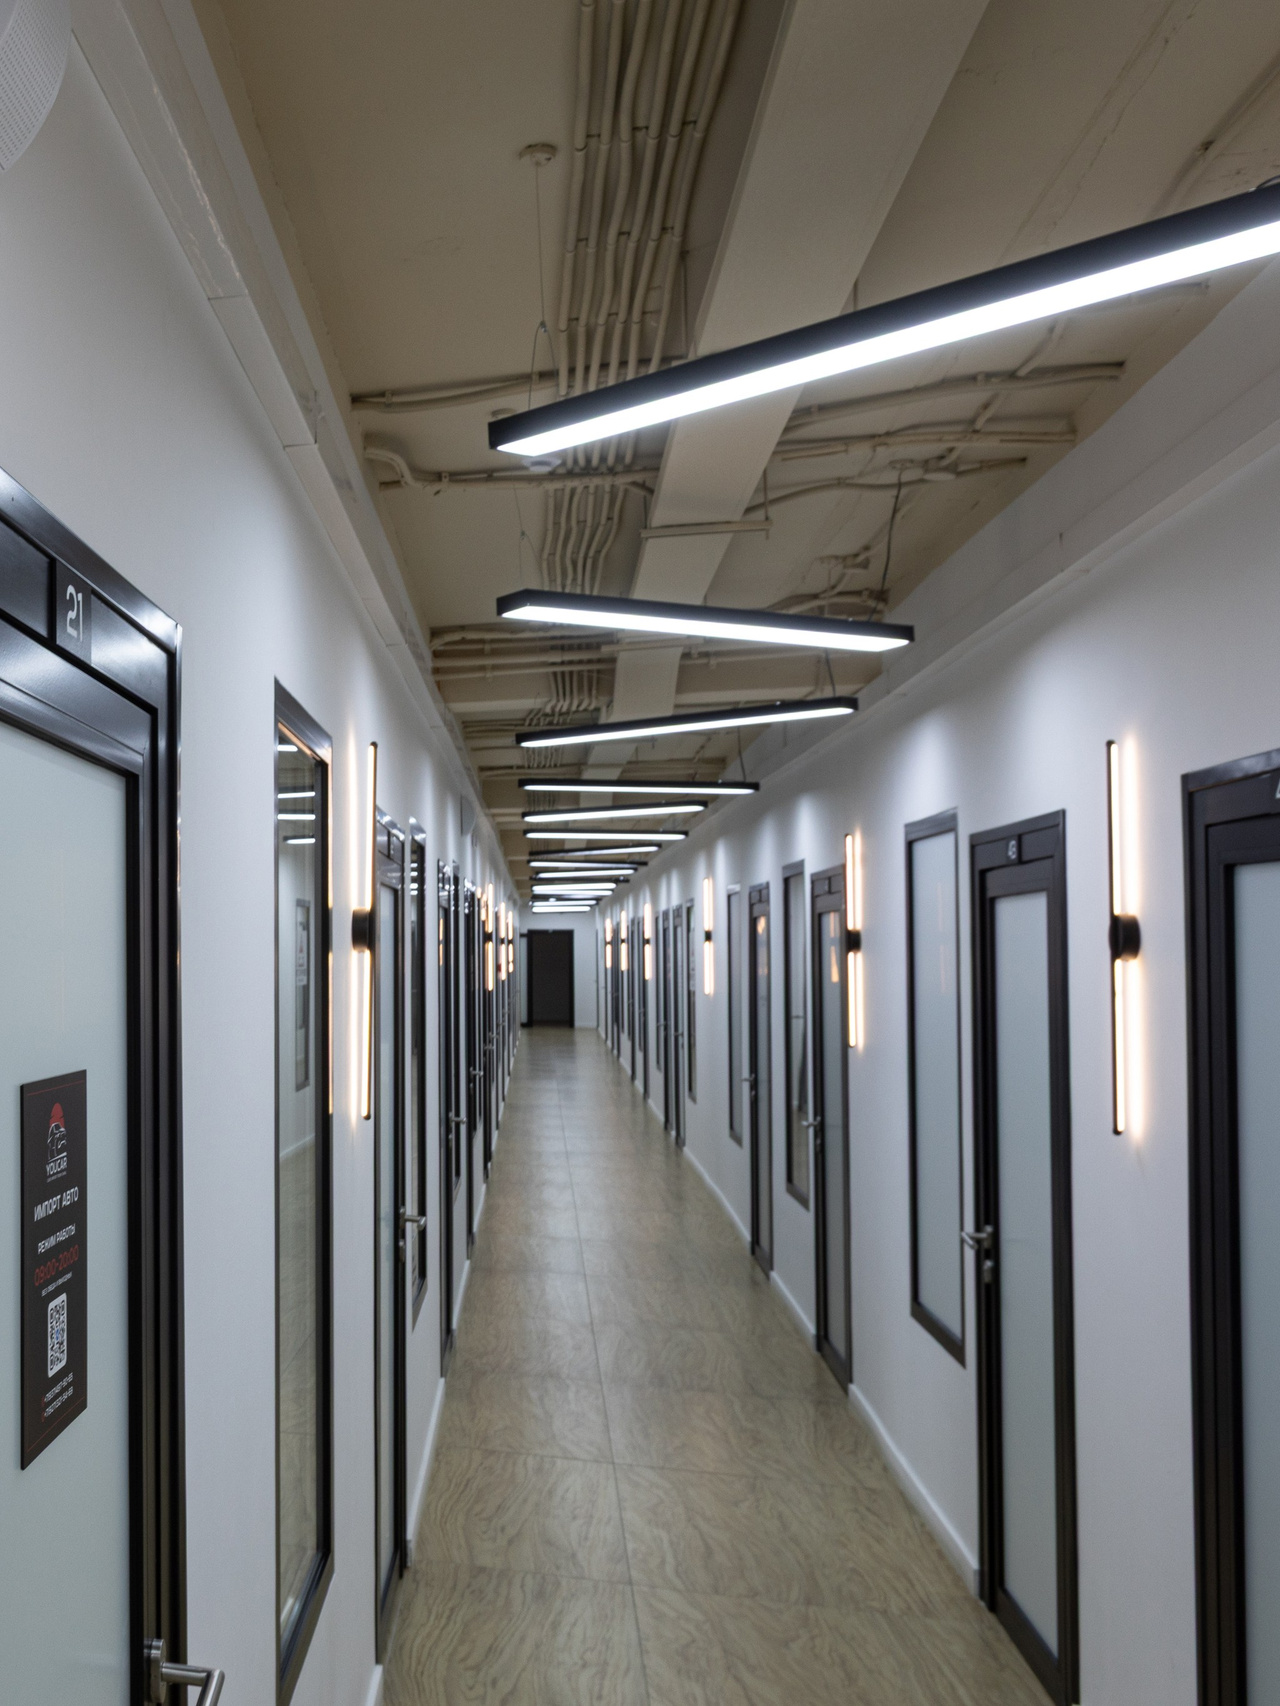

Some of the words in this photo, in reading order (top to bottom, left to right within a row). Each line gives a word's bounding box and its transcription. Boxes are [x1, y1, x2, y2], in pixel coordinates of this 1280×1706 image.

[66, 584, 83, 642] 21
[46, 1157, 67, 1176] YOUCAR
[34, 1194, 61, 1222] ИМПОРТ
[62, 1186, 79, 1208] АВТО
[38, 1233, 57, 1255] РЕЖИМ
[56, 1223, 76, 1244] РАБОТЫ
